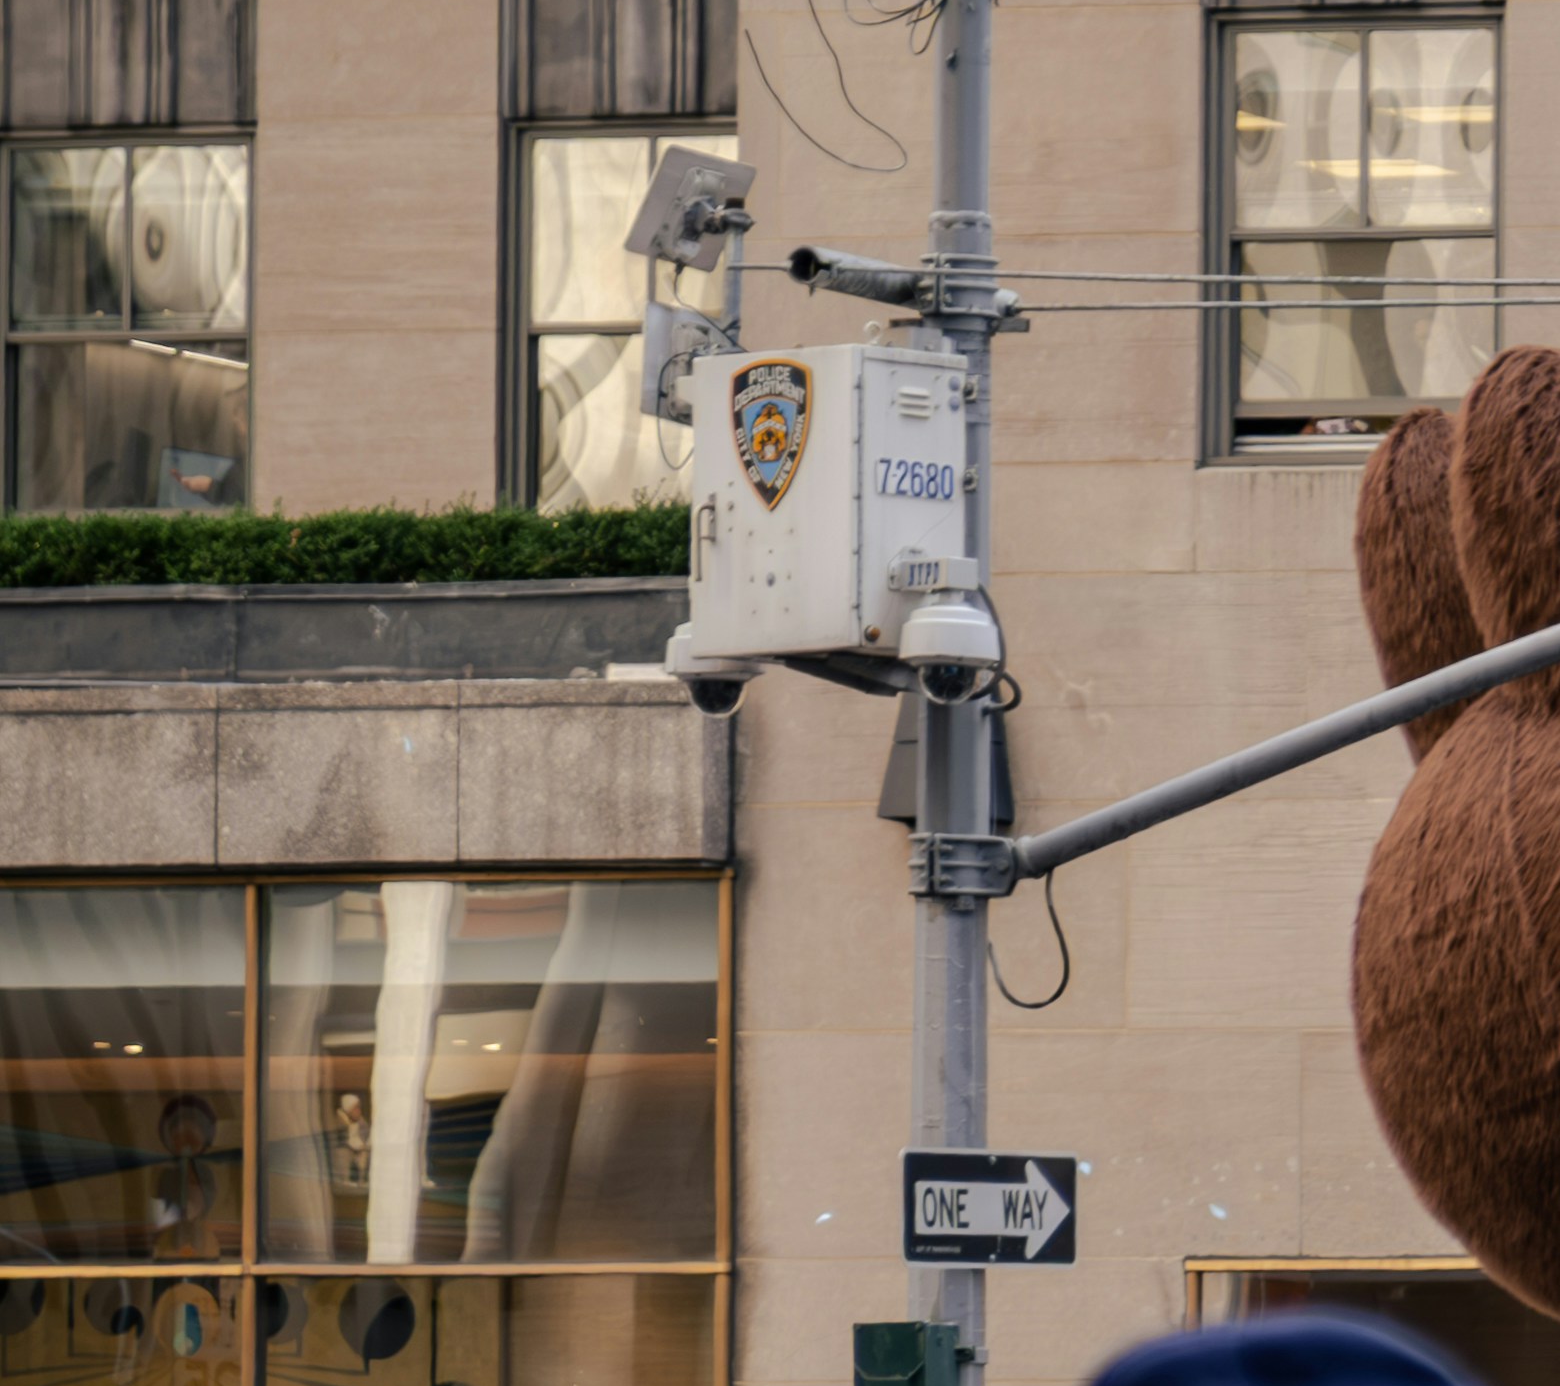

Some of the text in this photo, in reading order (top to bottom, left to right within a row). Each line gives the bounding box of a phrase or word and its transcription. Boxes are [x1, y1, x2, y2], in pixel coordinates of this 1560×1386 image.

[748, 365, 791, 385] POLICE
[734, 380, 805, 412] DEPARTMENT
[735, 427, 753, 462] CITY
[790, 414, 806, 452] YORK
[879, 458, 954, 500] 7-2680
[922, 1186, 1048, 1231] ONE WAY
